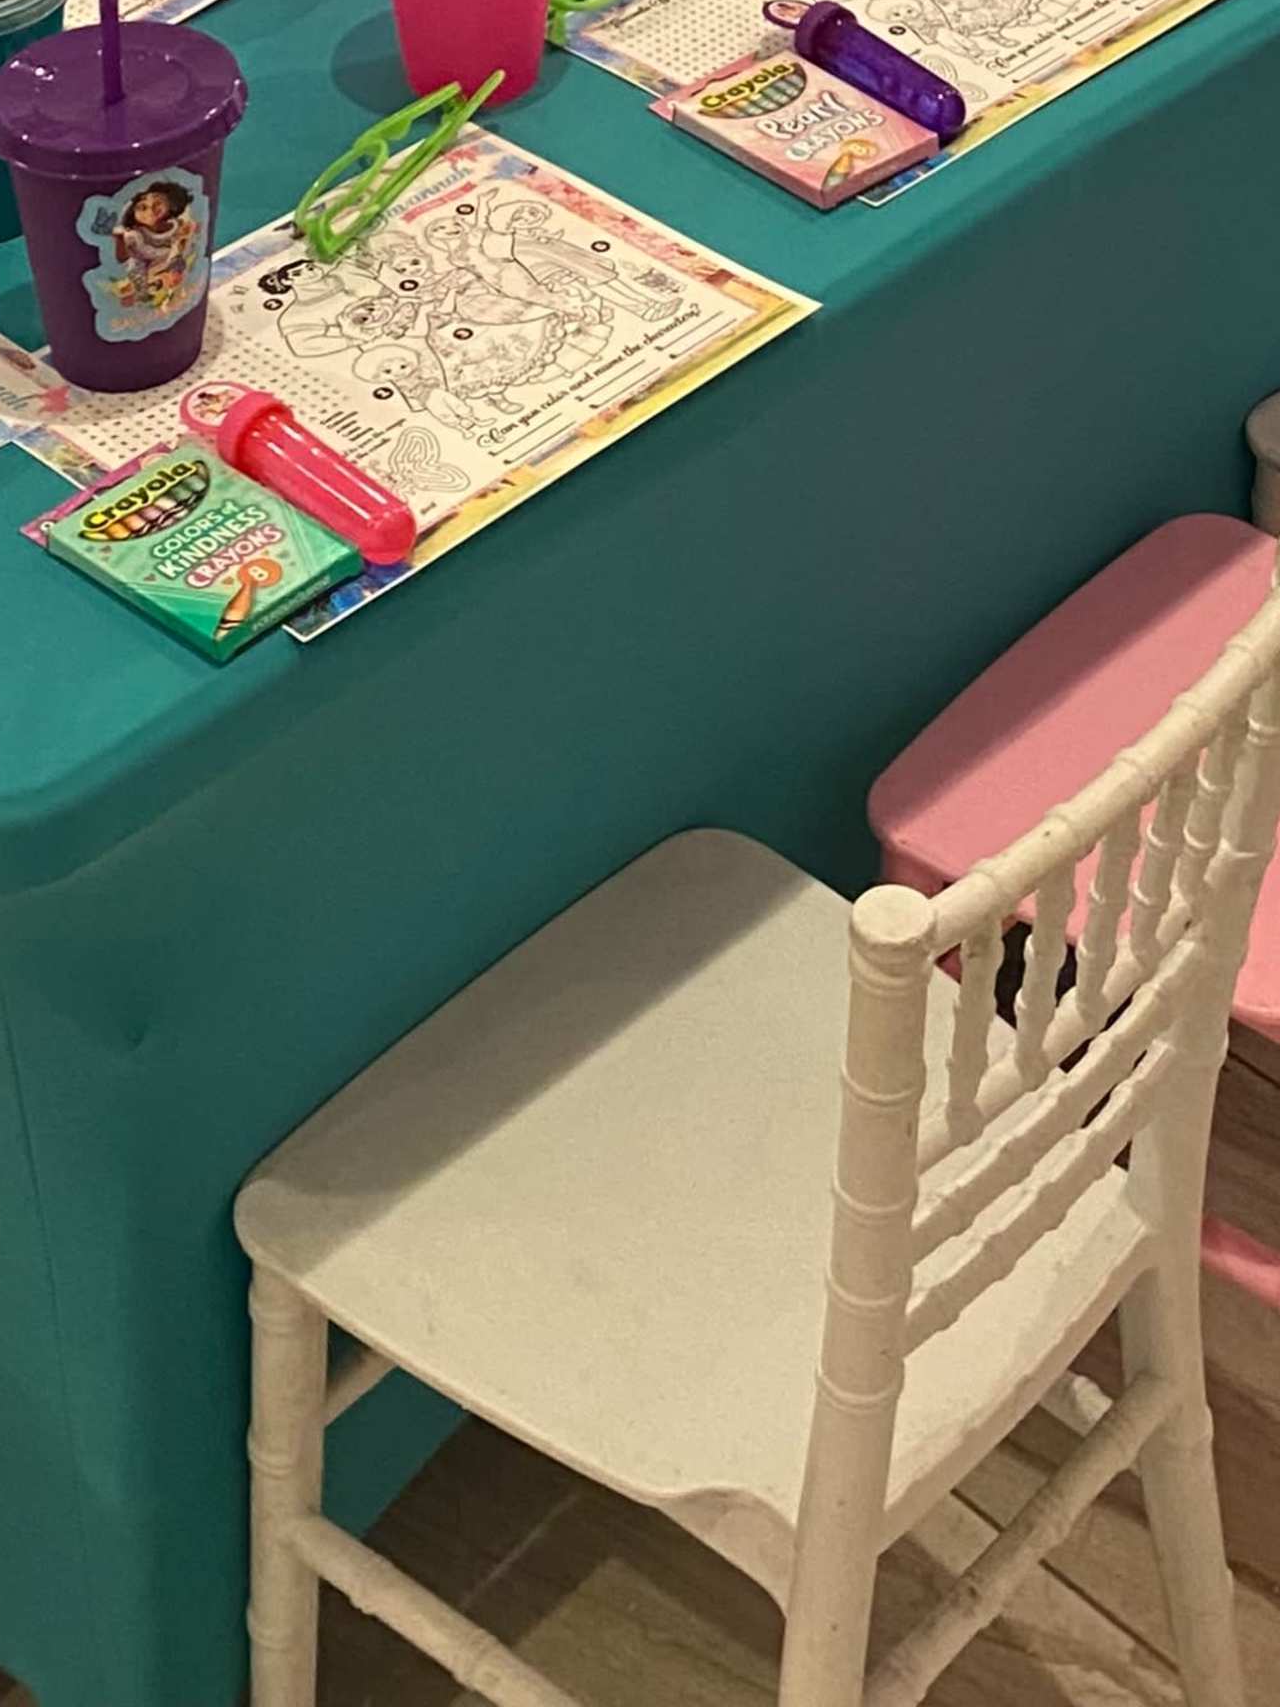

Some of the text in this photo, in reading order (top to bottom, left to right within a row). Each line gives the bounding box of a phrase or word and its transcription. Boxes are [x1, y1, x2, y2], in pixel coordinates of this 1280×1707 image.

[700, 61, 793, 111] Crayola
[784, 109, 885, 163] CRAYONS
[82, 462, 195, 531] Crayola
[152, 507, 223, 560] COLORS
[184, 524, 284, 588] CRAYONS
